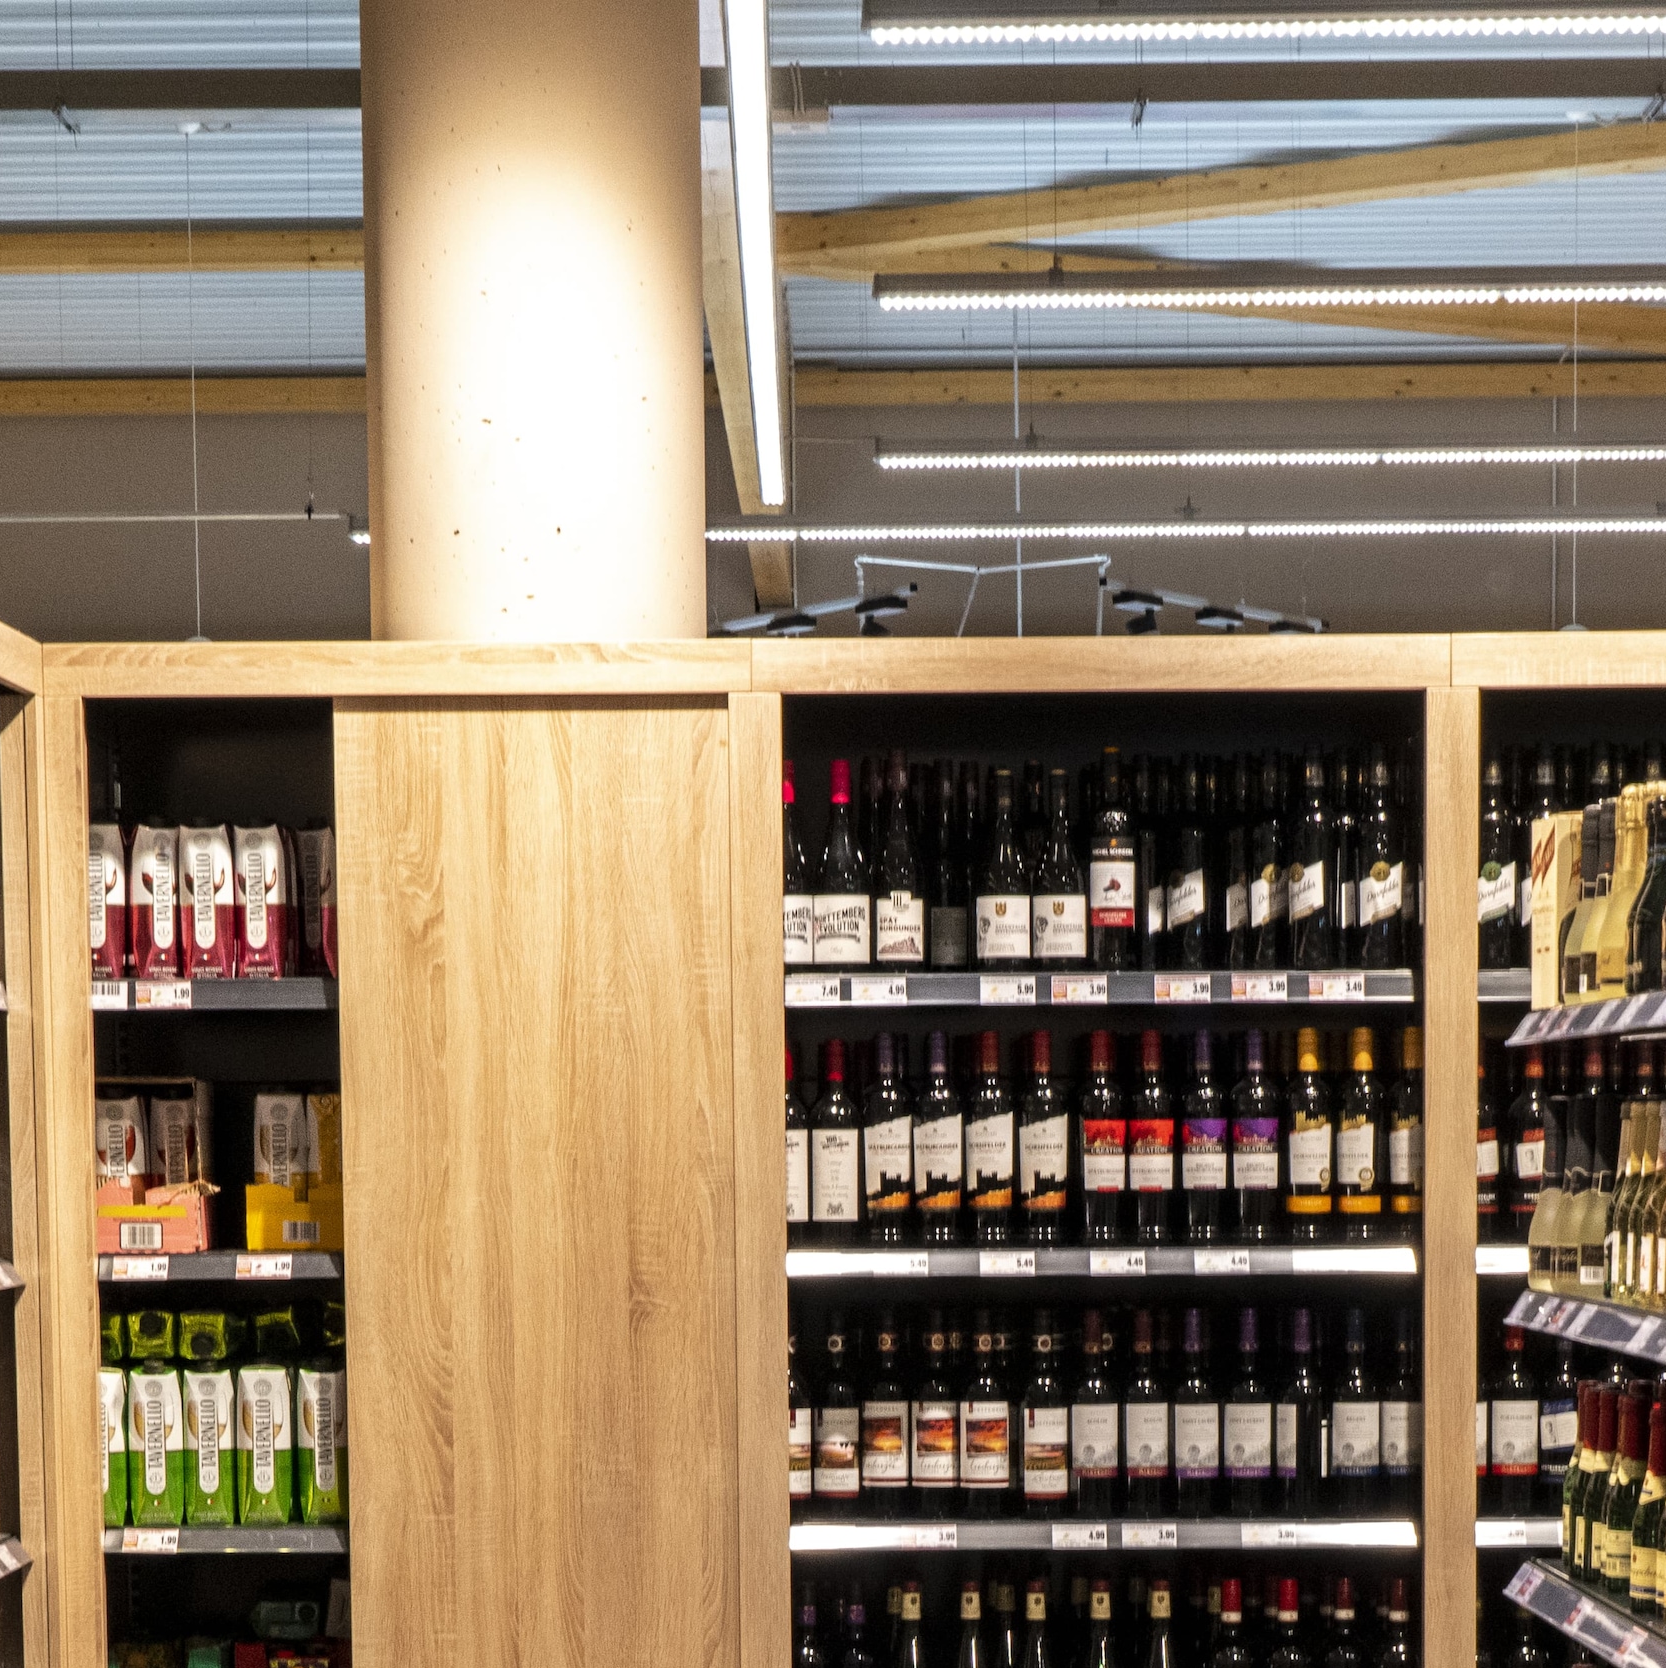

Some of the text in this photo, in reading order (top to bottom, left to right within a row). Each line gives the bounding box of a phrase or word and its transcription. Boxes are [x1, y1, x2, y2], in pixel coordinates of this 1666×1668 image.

[173, 986, 190, 1000] 1.99
[151, 1261, 167, 1273] 1.99
[274, 1260, 291, 1273] 1.99
[161, 1534, 178, 1546] 1.99
